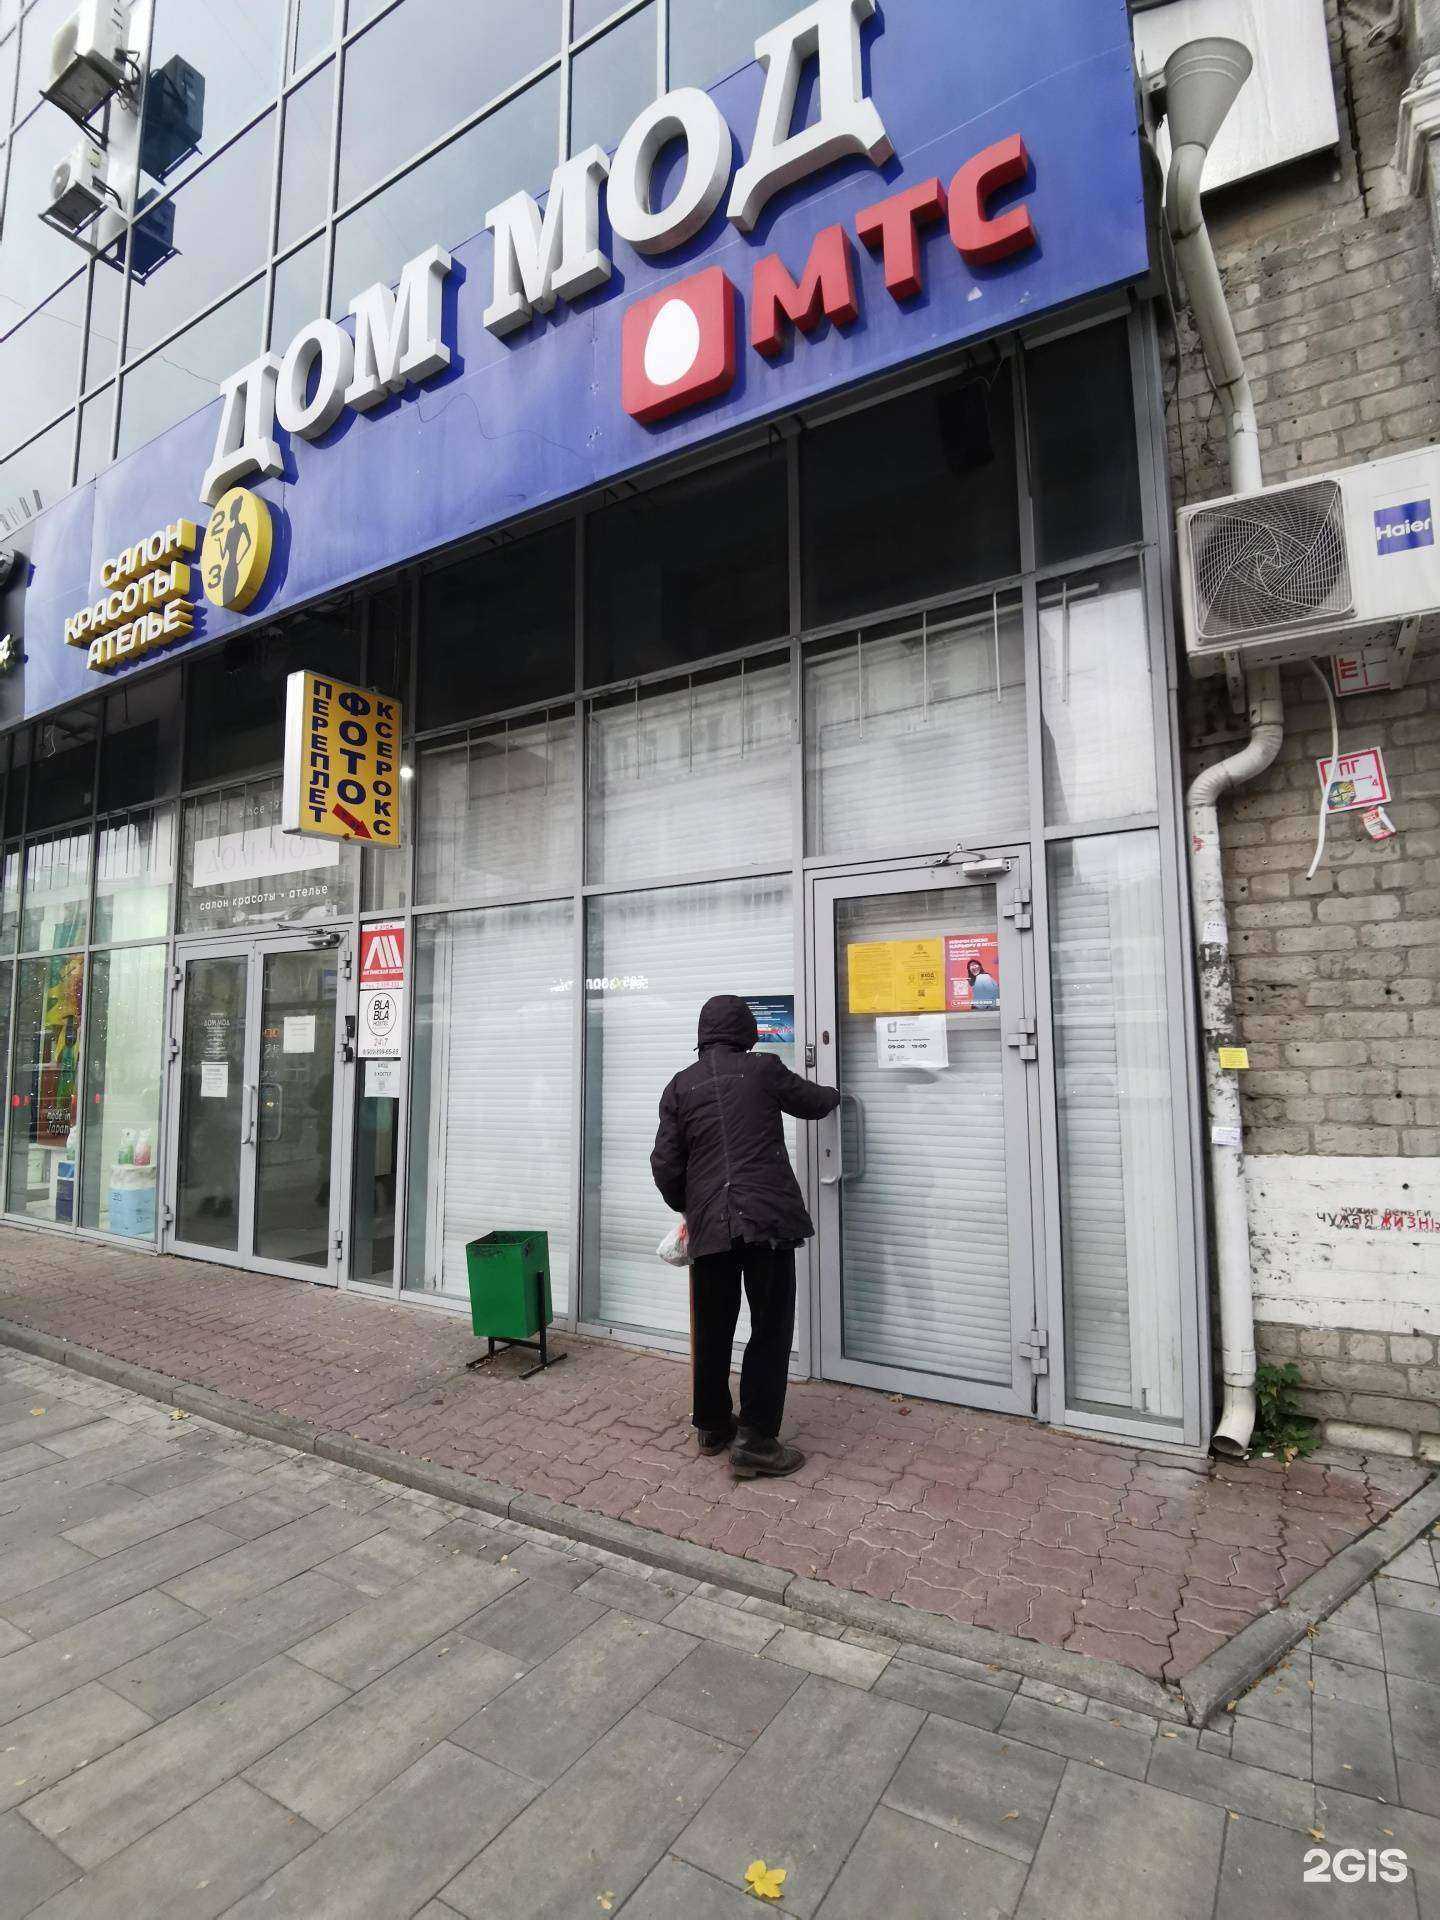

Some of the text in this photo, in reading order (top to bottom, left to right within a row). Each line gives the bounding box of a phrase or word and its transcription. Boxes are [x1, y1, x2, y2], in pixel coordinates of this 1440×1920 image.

[199, 0, 896, 504] ДОМ МОД
[752, 133, 1036, 357] МТС
[100, 518, 195, 590] САЛОН
[1375, 518, 1431, 541] Haier
[65, 560, 190, 645] КРАСОТЫ
[87, 598, 194, 671] АТЕЛЬЕ
[308, 679, 333, 823] ПЕРЕПЛЕТ
[336, 691, 371, 806] ФОТО
[372, 700, 394, 837] КСЕРОКС
[199, 884, 328, 911] салон красоты ателье
[373, 999, 390, 1010] BLA
[373, 1010, 390, 1021] BLA
